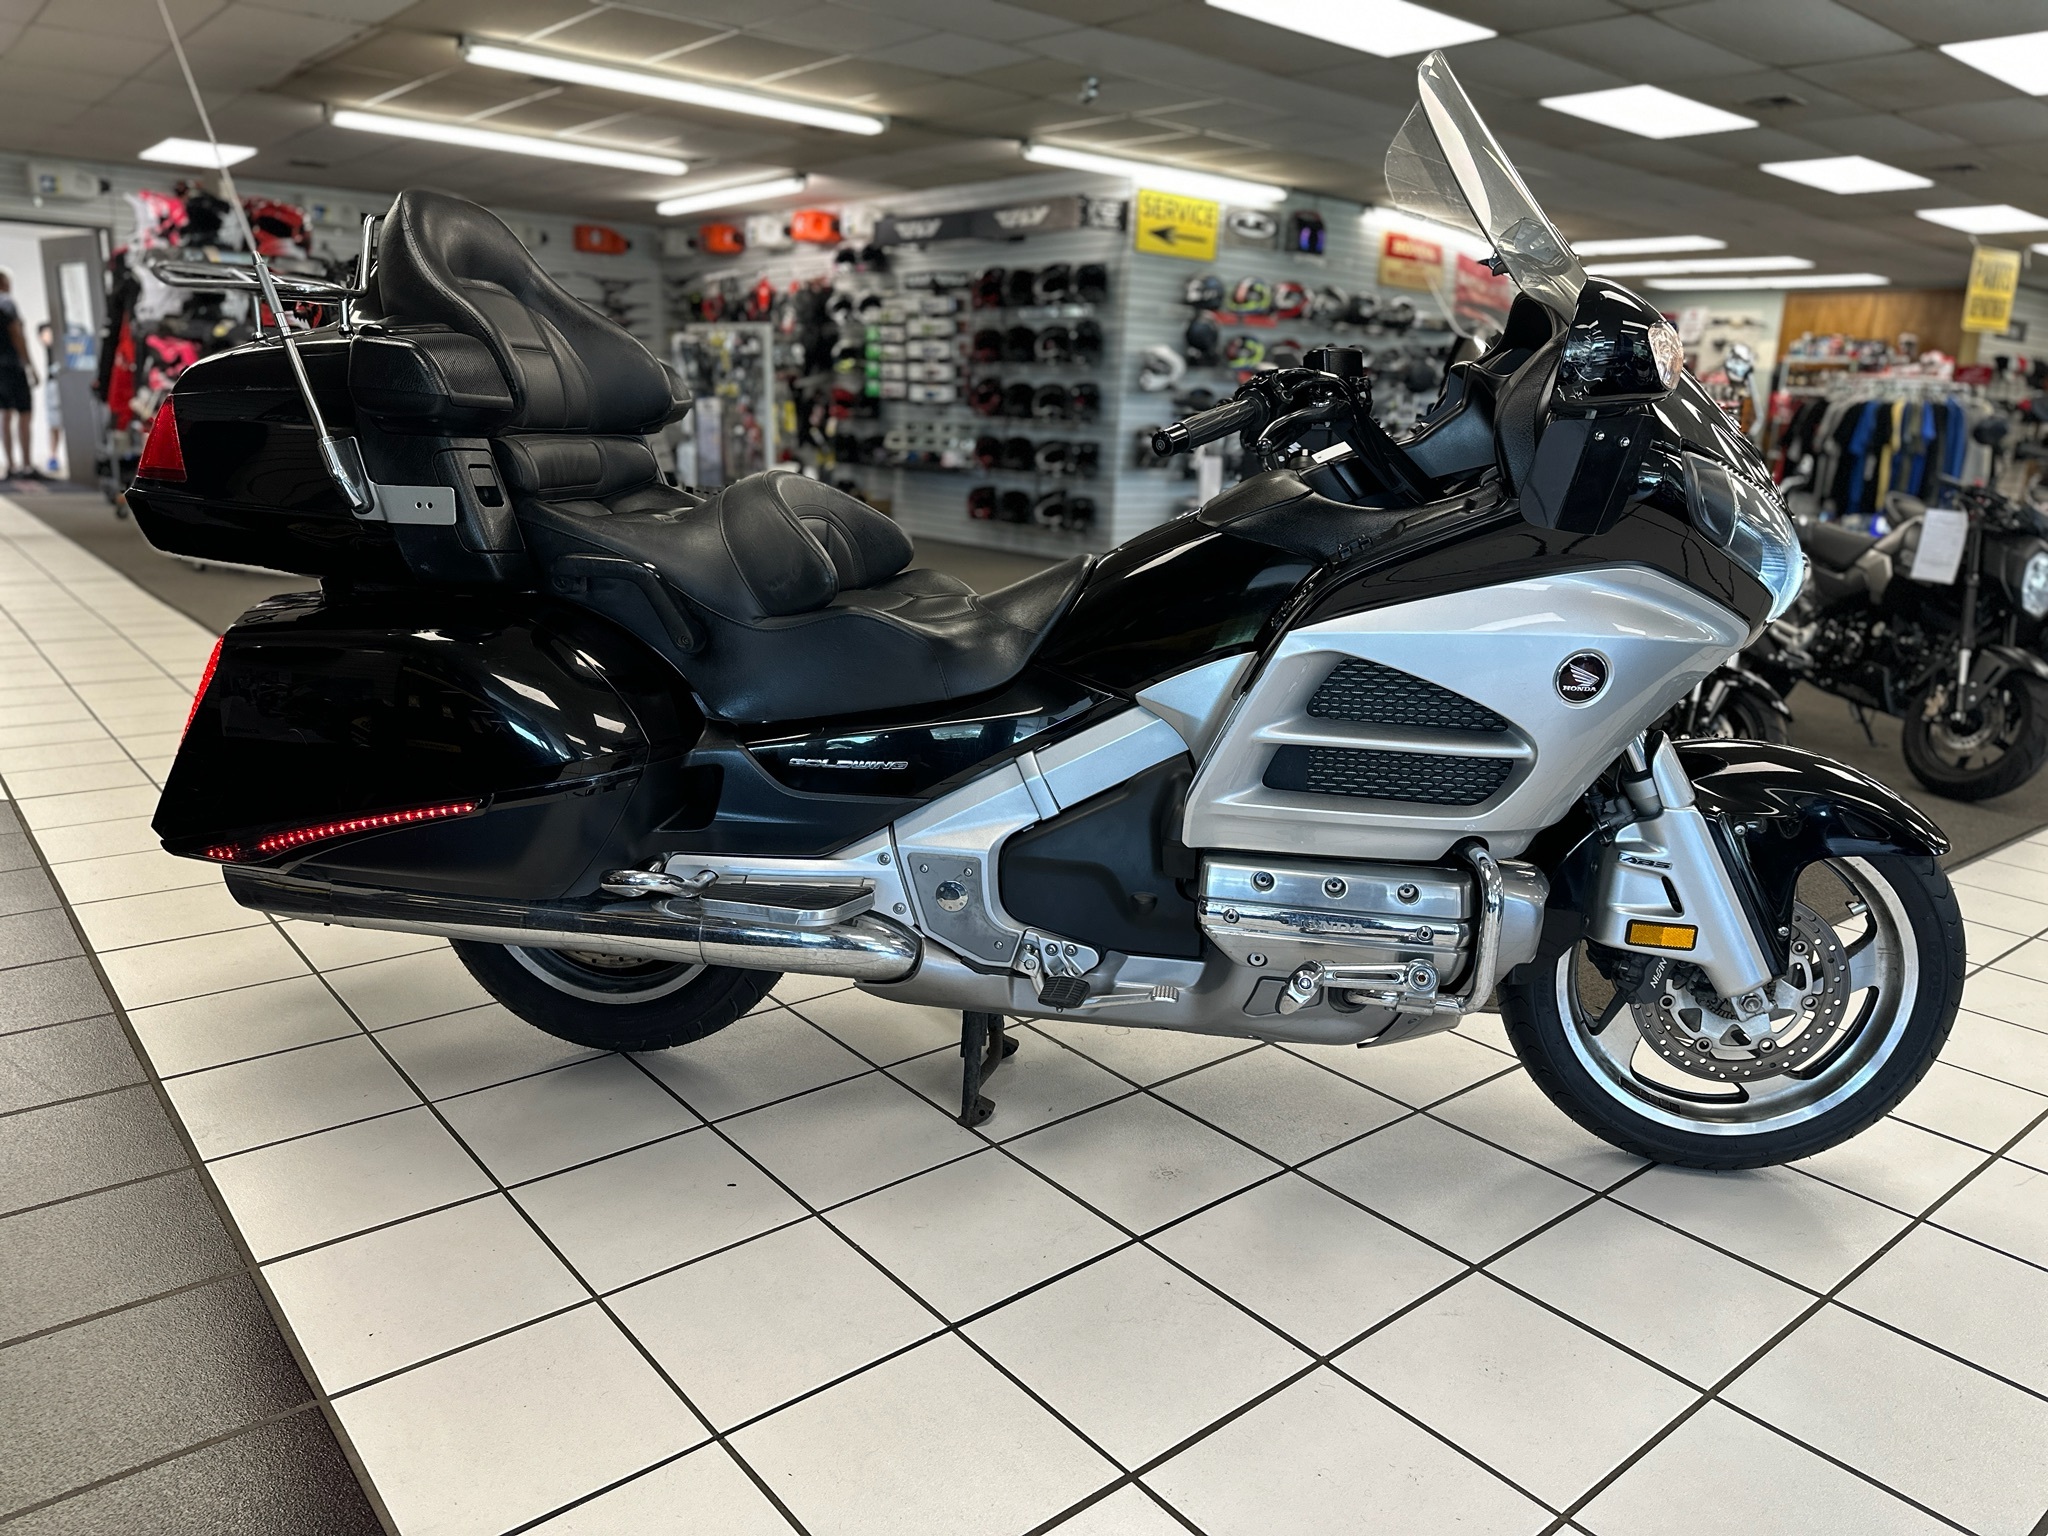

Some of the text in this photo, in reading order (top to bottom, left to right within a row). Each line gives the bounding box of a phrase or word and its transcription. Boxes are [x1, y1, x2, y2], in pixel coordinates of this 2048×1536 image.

[1142, 195, 1214, 228] SERVICE
[1620, 854, 1672, 870] ABS
[1287, 917, 1367, 934] HONDA
